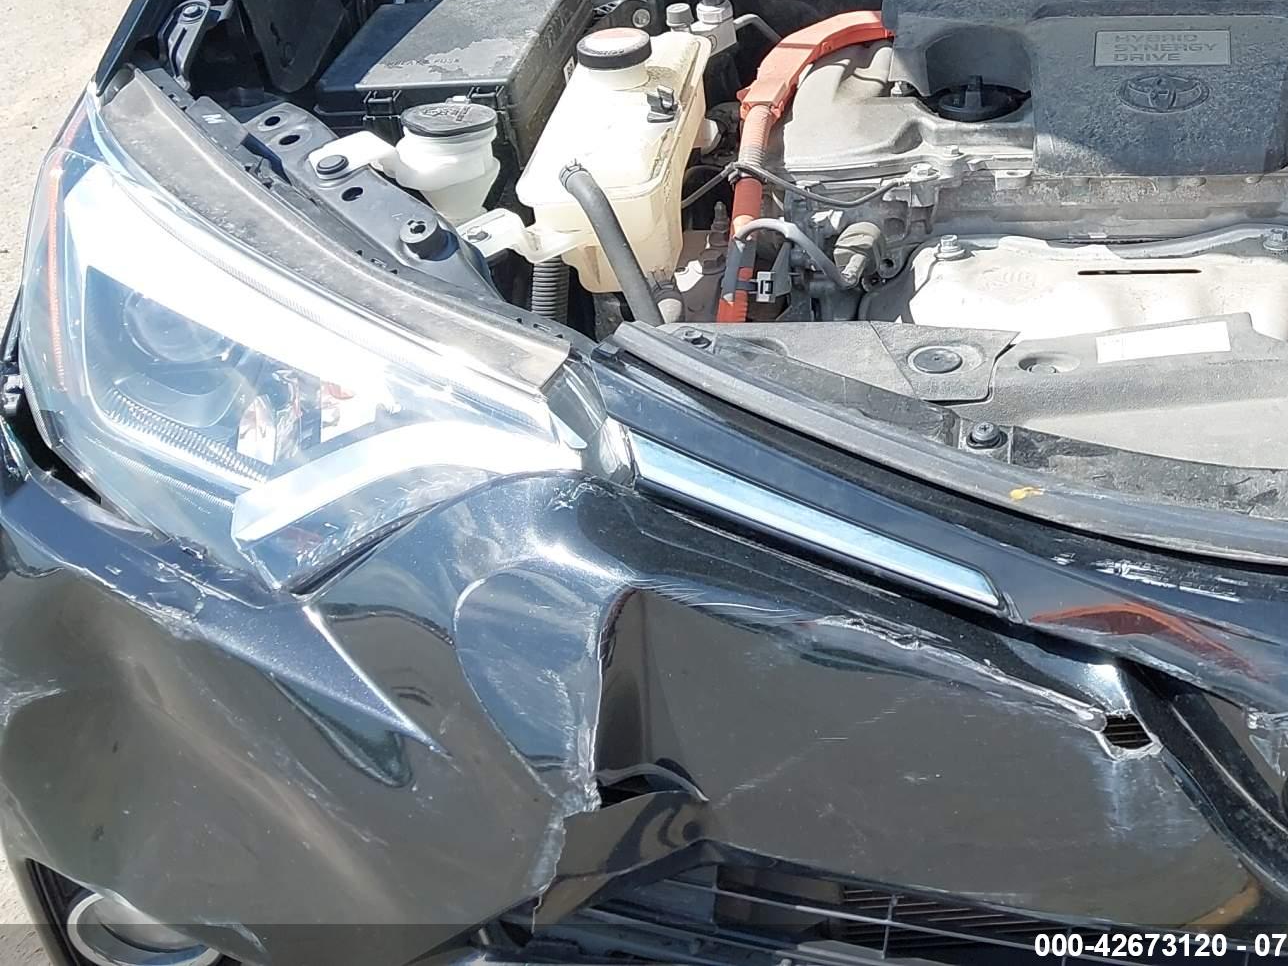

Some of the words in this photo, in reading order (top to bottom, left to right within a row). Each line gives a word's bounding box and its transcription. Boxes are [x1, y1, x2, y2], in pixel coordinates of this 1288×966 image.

[1114, 34, 1199, 43] HYBRID
[1113, 43, 1218, 52] SYNERGY
[1113, 53, 1181, 62] DRIVE
